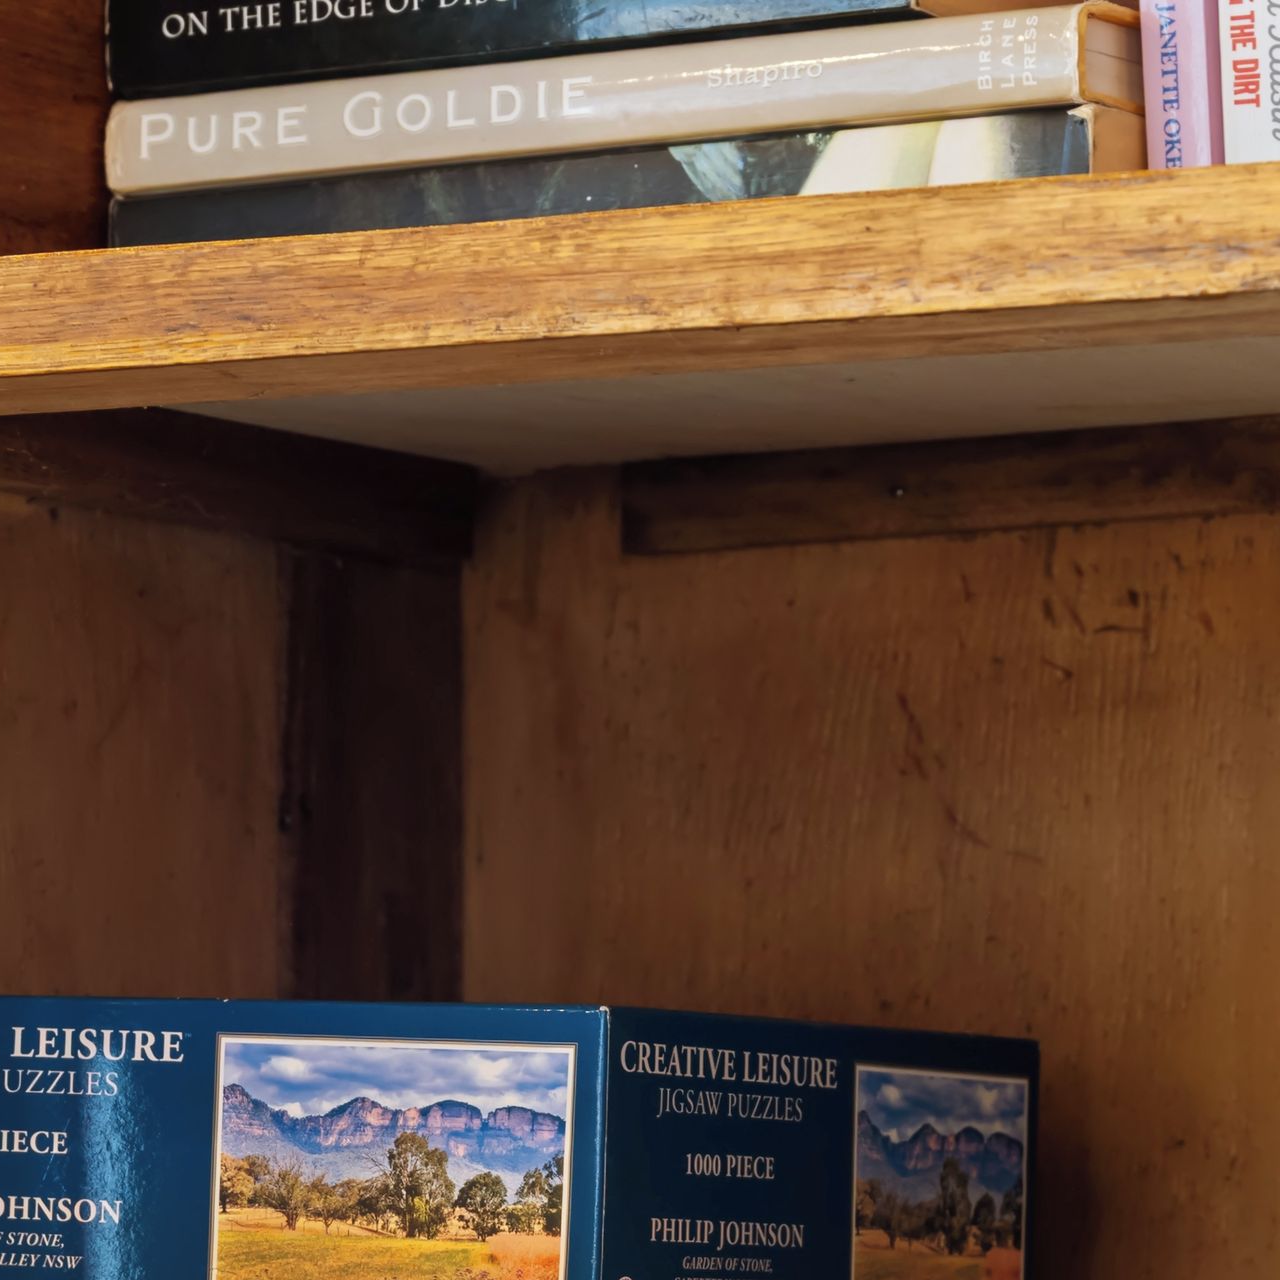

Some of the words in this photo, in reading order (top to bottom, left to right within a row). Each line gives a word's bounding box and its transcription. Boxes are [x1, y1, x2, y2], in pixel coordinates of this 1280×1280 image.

[162, 11, 208, 39] ON
[218, 3, 281, 32] THE
[293, 0, 374, 25] EDGE
[1230, 10, 1257, 52] THE
[977, 20, 995, 90] BIRCH
[1000, 17, 1017, 88] LANE
[1022, 15, 1039, 86] PRESS
[1155, 3, 1181, 113] JANETTE
[707, 63, 823, 88] Shapiro
[1232, 58, 1261, 108] DIRT
[138, 105, 310, 160] PURE
[342, 75, 595, 138] GOLDIE
[1163, 117, 1183, 169] OKE
[10, 1026, 185, 1063] LEISURE
[619, 1040, 737, 1081] CREATIVE
[742, 1050, 839, 1090] LEISURE
[656, 1087, 725, 1118] JIGSAW
[727, 1093, 804, 1123] PUZZLES
[685, 1152, 722, 1177] 1000
[725, 1155, 775, 1180] PIECE
[6, 1231, 66, 1249] STONE,
[650, 1217, 715, 1245] PHILIP
[716, 1220, 805, 1251] JOHNSON
[42, 1254, 83, 1270] NSW
[682, 1256, 722, 1271] GARDEN
[724, 1257, 738, 1272] OF
